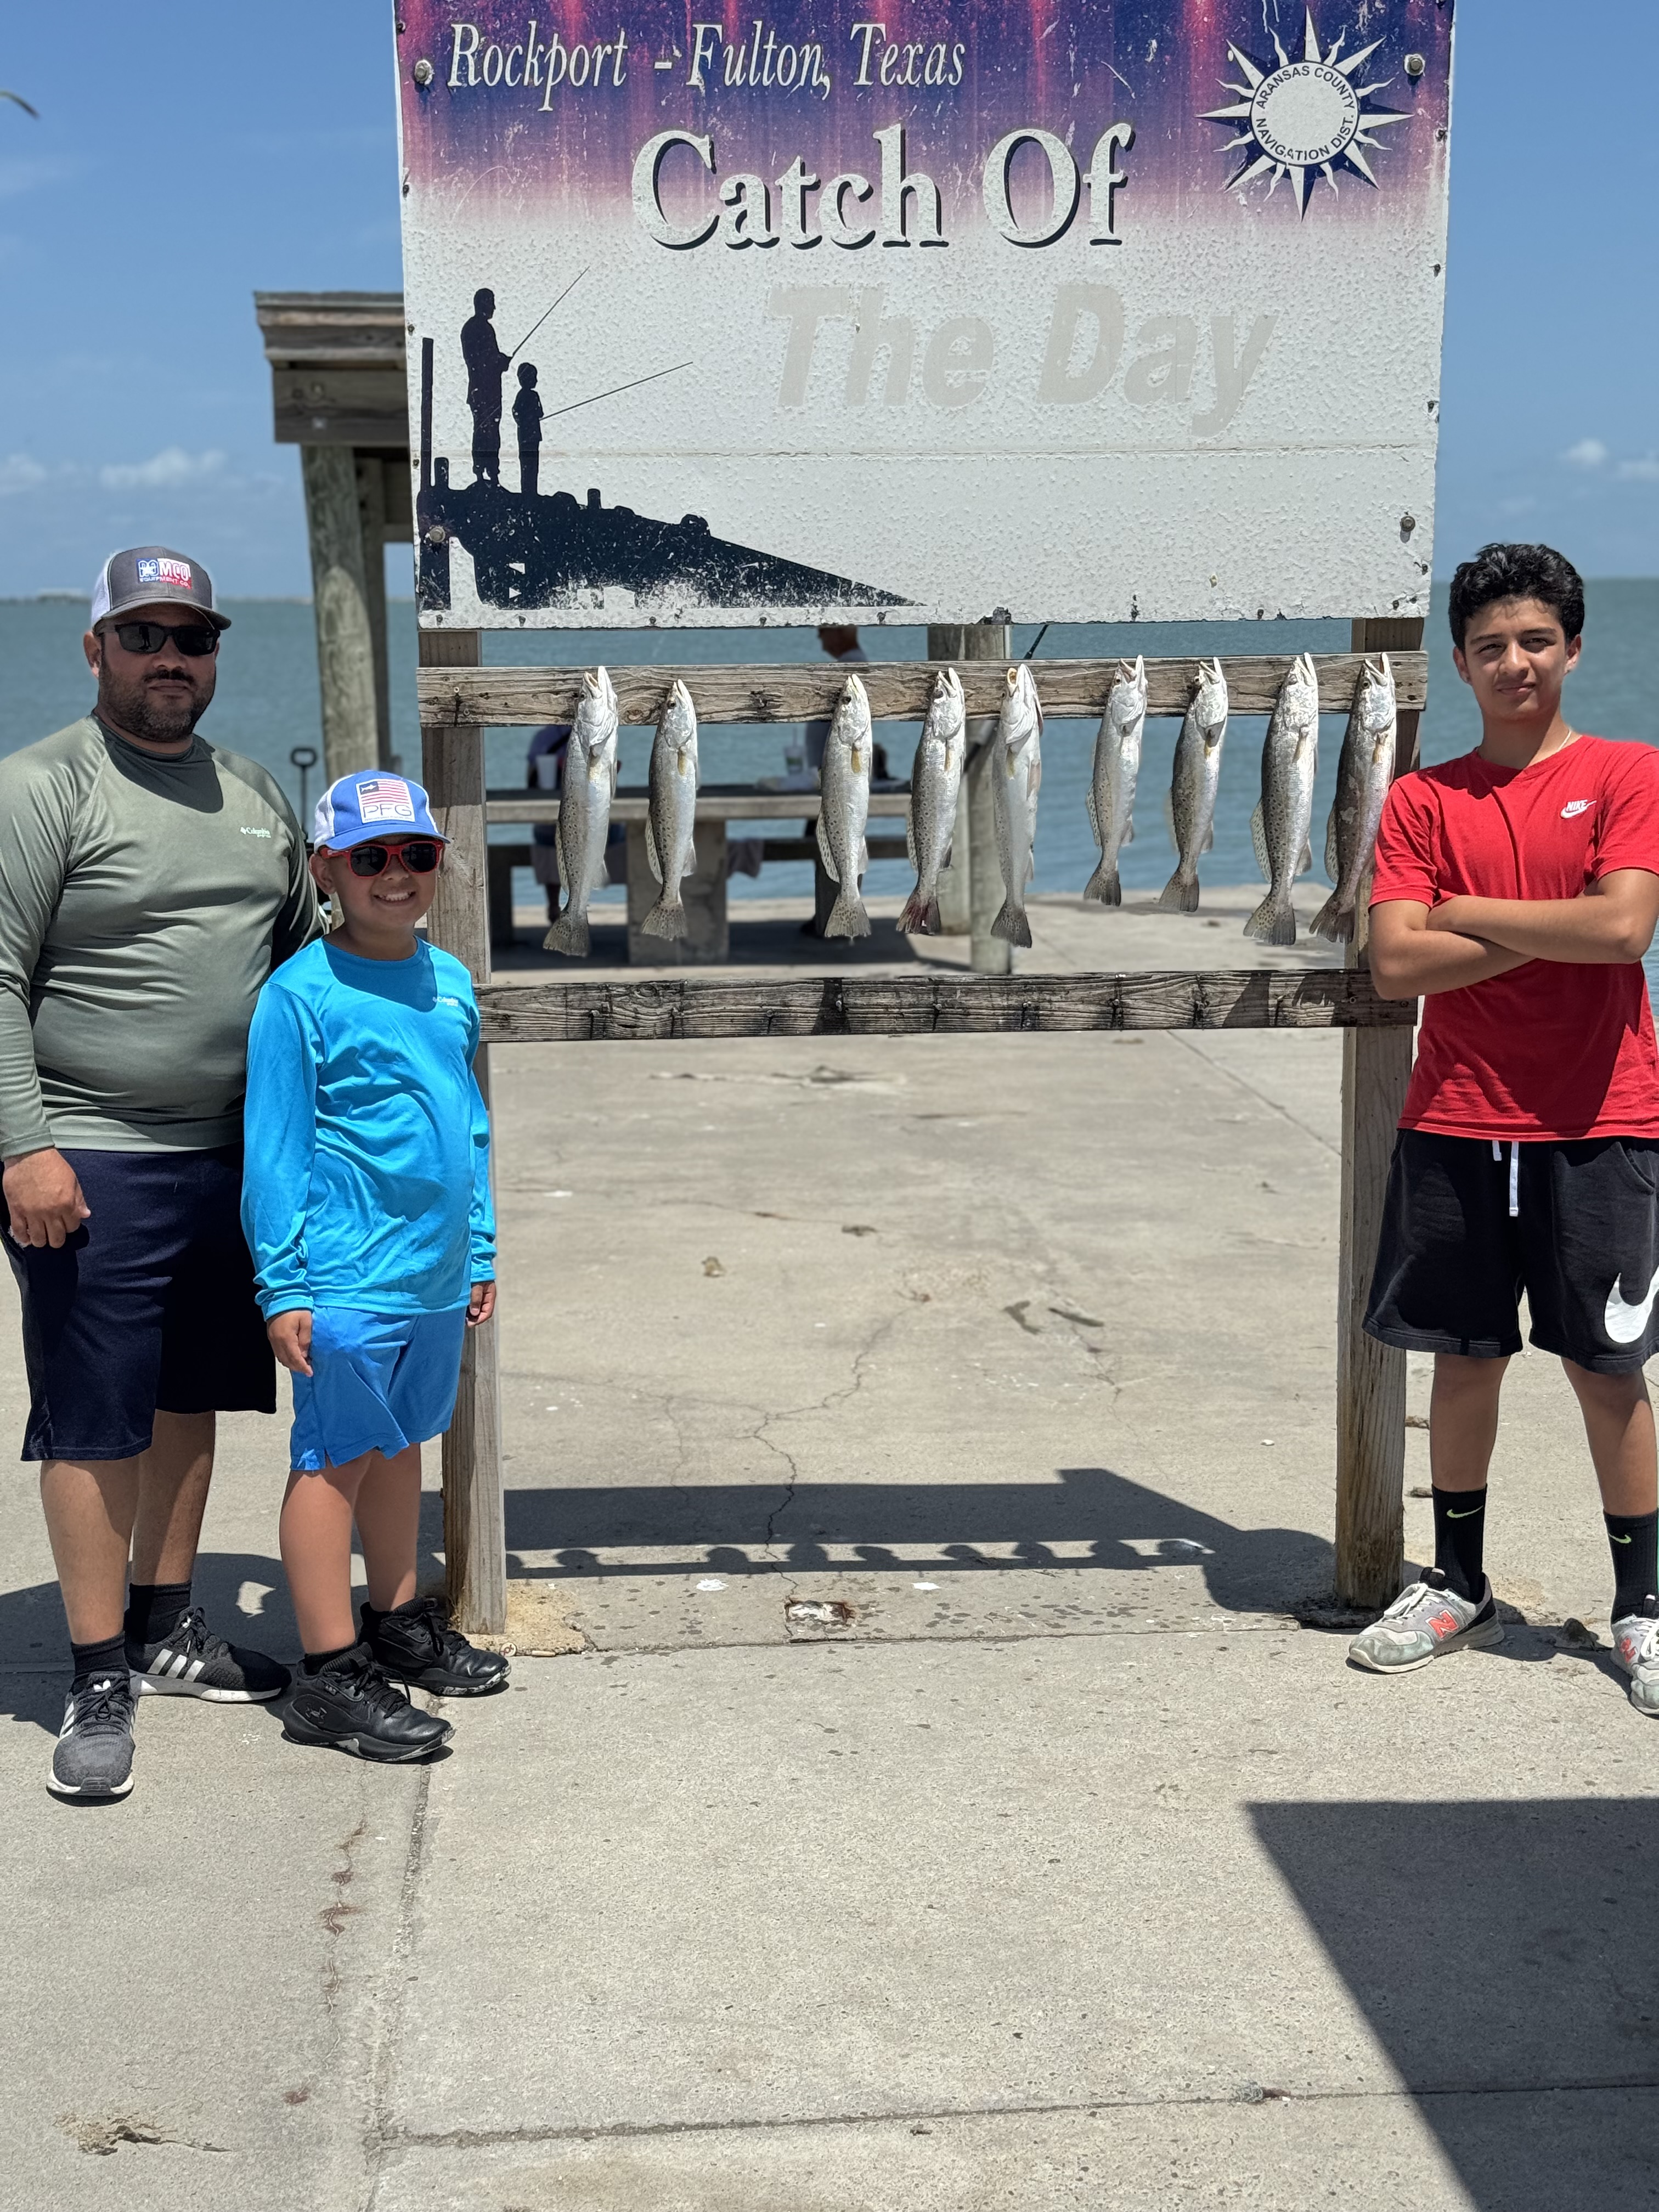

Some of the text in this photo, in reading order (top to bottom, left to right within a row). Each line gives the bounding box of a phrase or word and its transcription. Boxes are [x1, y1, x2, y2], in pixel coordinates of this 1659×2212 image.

[448, 21, 628, 112] Rockport
[686, 20, 831, 100] Fulton,
[849, 22, 964, 87] Texas
[1256, 65, 1355, 109] ARANSAS COUNTY
[1256, 115, 1354, 161] NAVIGATION DIST.
[631, 122, 1136, 250] Catch Of
[767, 283, 1279, 438] The Day
[363, 803, 412, 818] PFG
[1566, 799, 1588, 812] NIKE
